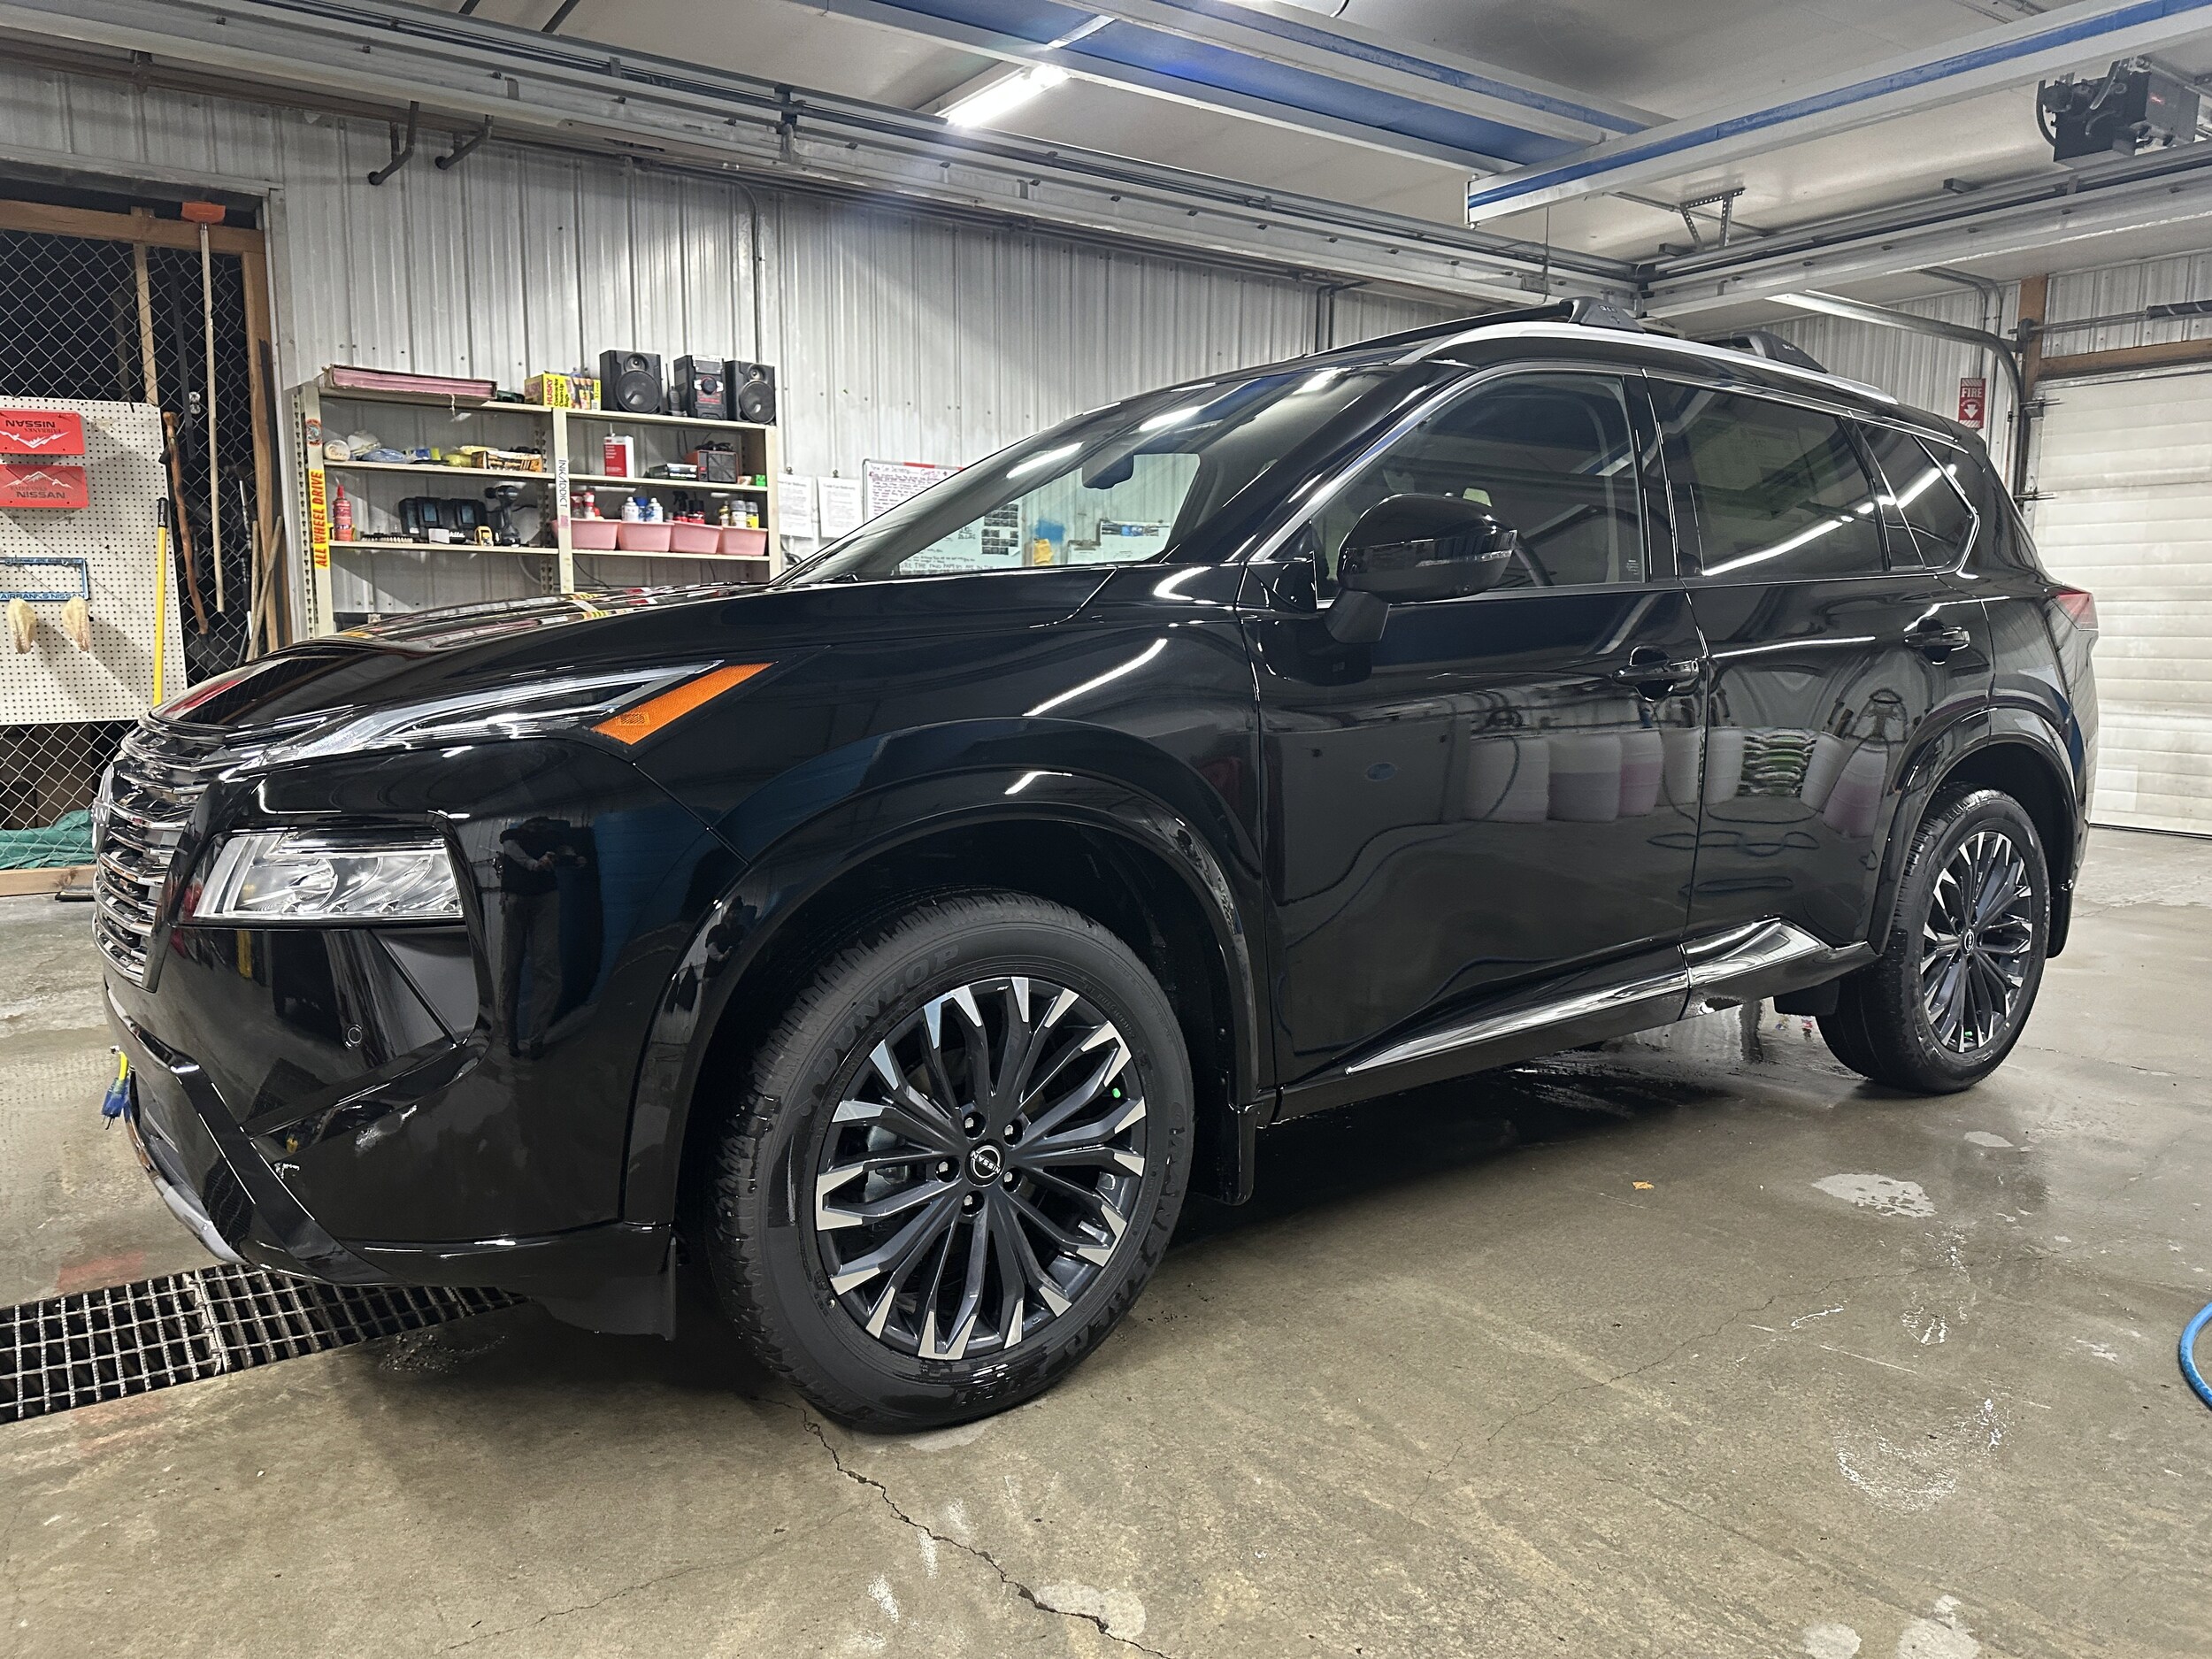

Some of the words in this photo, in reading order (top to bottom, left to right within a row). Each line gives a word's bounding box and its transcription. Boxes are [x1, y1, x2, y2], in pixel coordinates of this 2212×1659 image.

[1961, 388, 1982, 398] FIRE
[5, 419, 56, 428] NISSAN
[311, 471, 324, 505] DRIVE
[312, 509, 326, 546] WHEEL
[314, 547, 328, 568] ALL
[813, 944, 959, 1082] DUNLOP
[970, 1150, 1001, 1174] NISSAN
